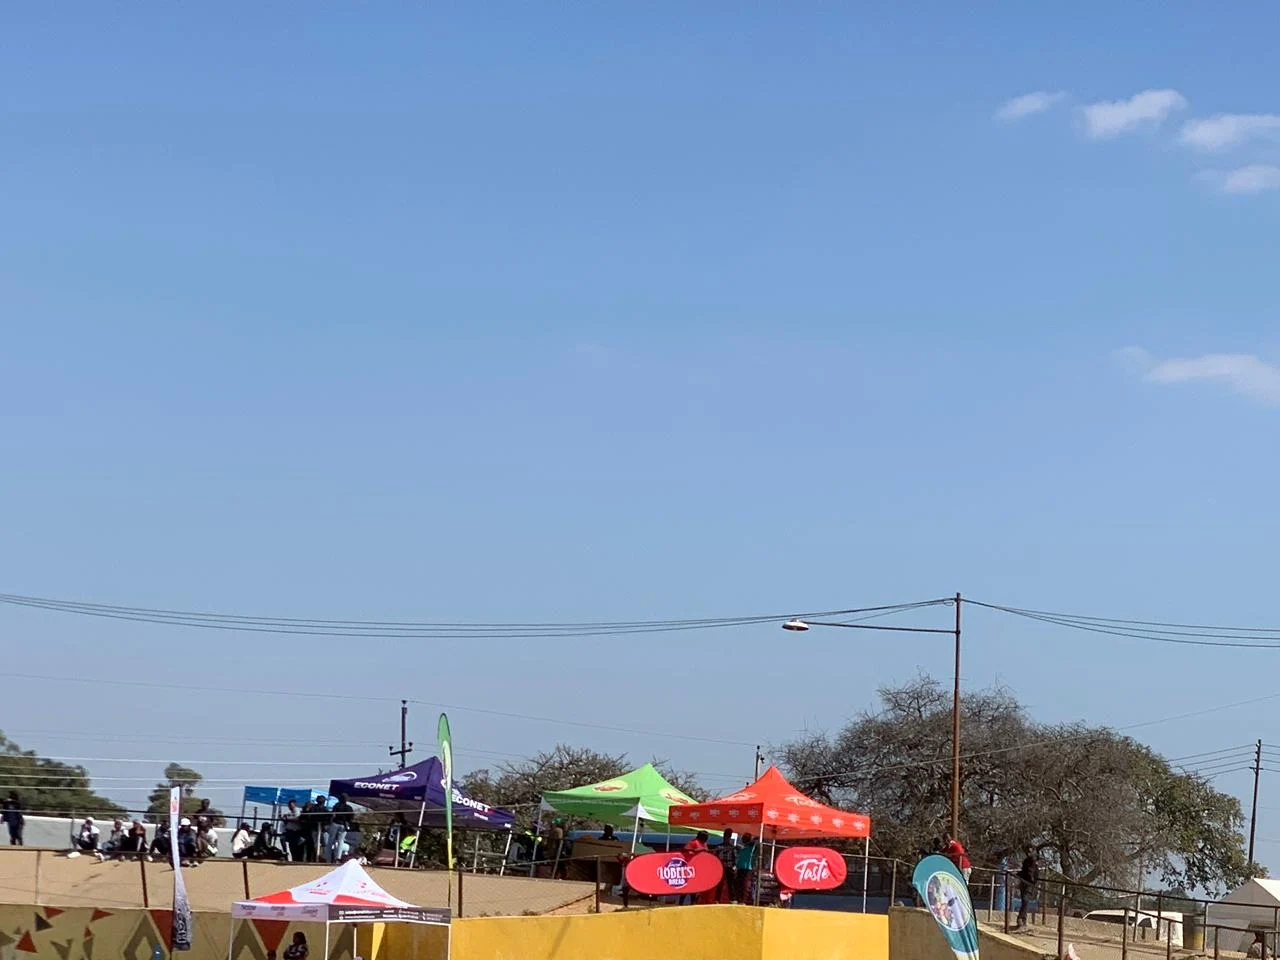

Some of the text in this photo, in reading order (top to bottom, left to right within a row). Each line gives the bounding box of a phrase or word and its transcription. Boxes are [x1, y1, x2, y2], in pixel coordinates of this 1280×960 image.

[353, 781, 399, 791] ECONET
[451, 794, 492, 813] ECONET
[794, 858, 830, 883] Taste
